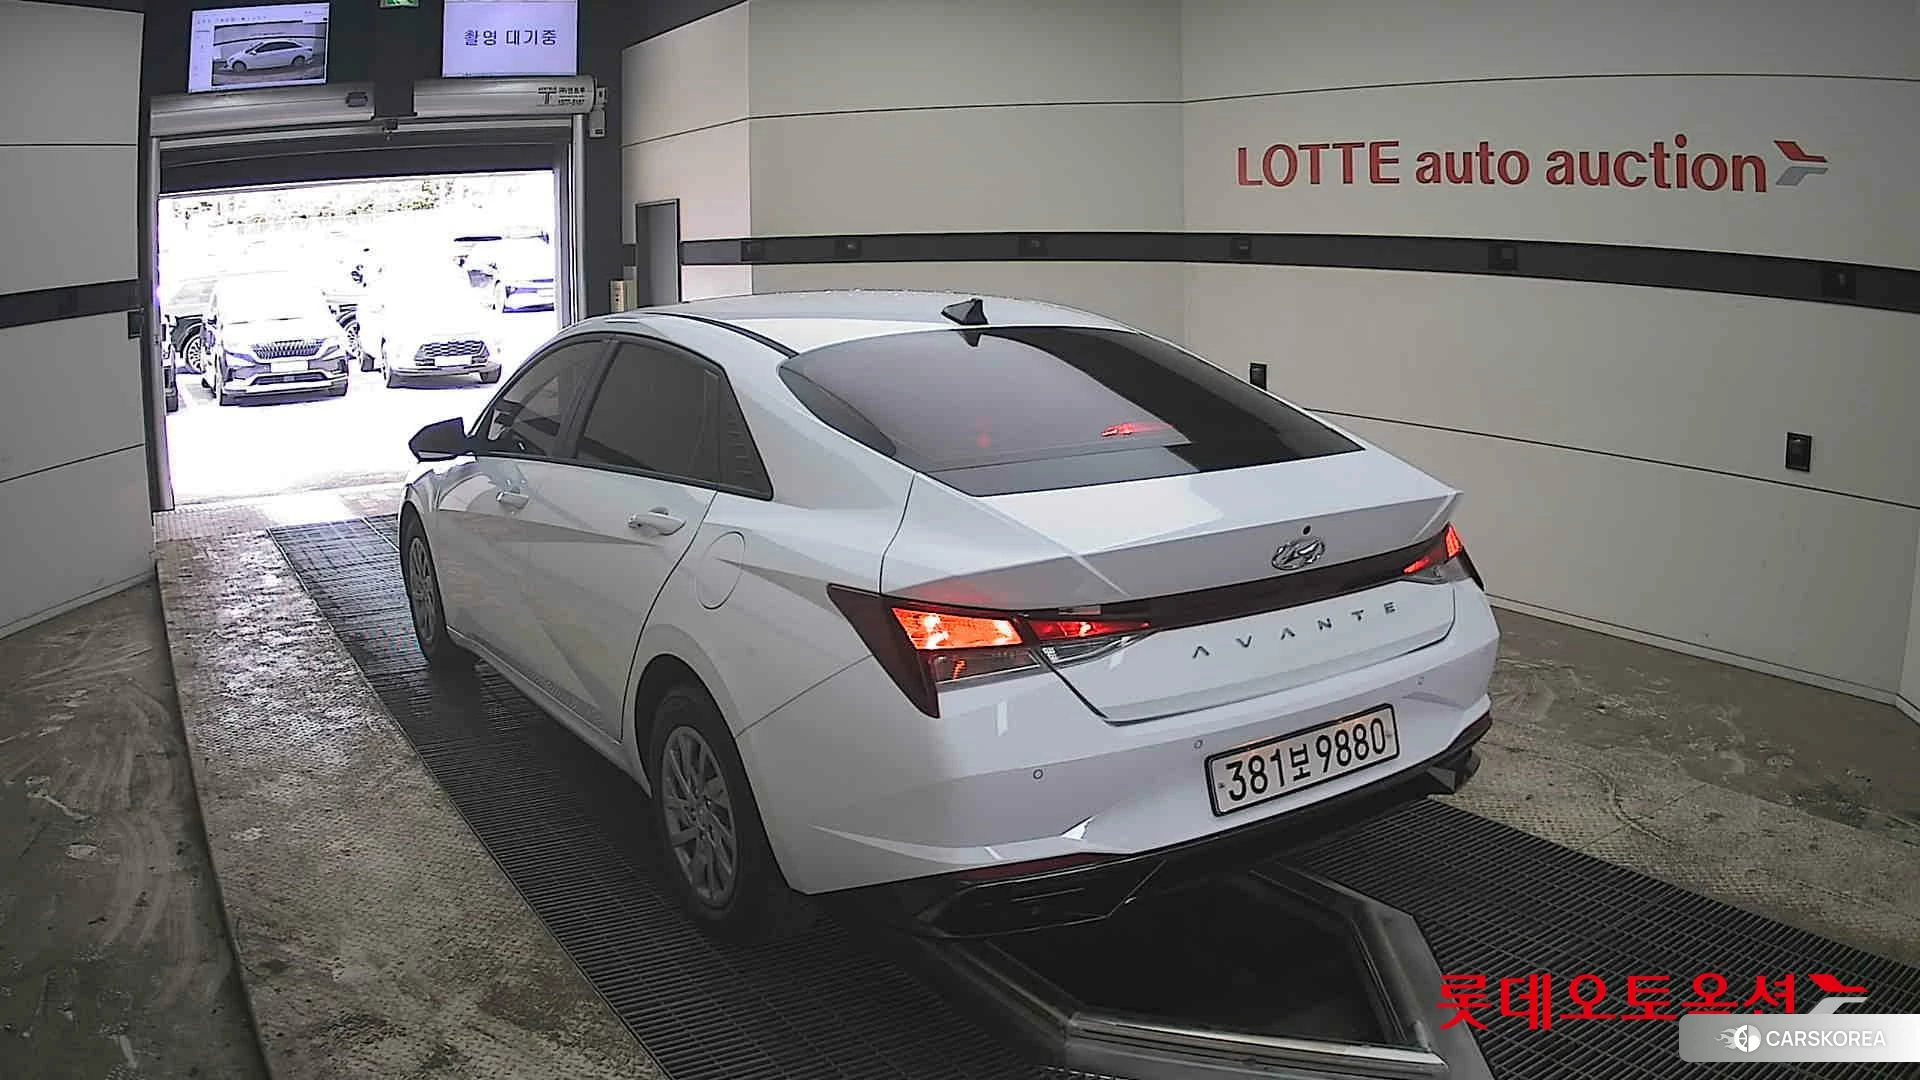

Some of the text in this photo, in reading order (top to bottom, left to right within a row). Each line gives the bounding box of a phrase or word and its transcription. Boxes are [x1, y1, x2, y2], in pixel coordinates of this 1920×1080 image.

[506, 29, 556, 46] 대기중
[1238, 134, 1767, 193] LOTTE auto auction
[1192, 601, 1397, 659] AVANTE
[1225, 717, 1386, 801] 381보9880
